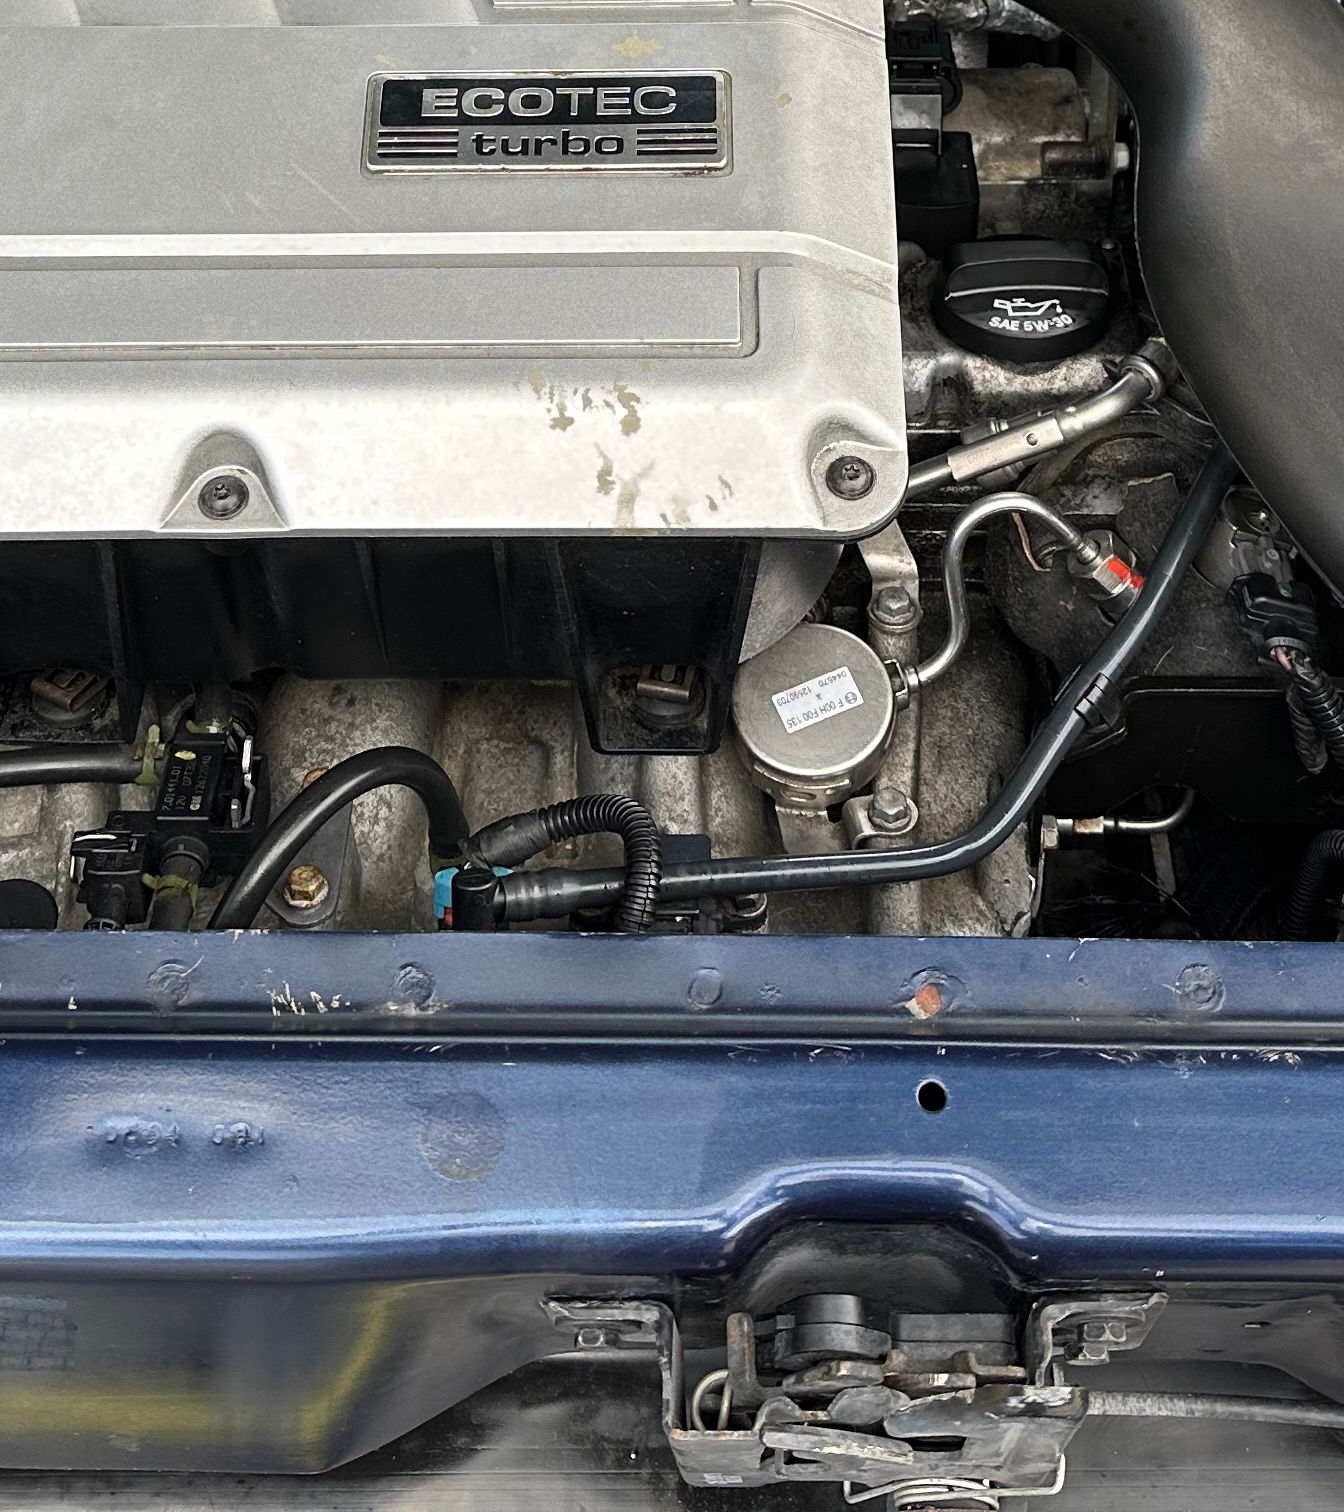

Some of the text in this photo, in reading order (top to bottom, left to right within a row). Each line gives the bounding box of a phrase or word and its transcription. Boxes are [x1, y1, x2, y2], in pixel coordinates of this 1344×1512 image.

[421, 85, 677, 118] ECOTEC
[471, 129, 625, 158] turbo
[988, 314, 1073, 332] SAE 5W-30
[836, 699, 844, 709] F
[787, 716, 802, 729] 135
[802, 708, 820, 721] F00
[190, 795, 203, 811] GM
